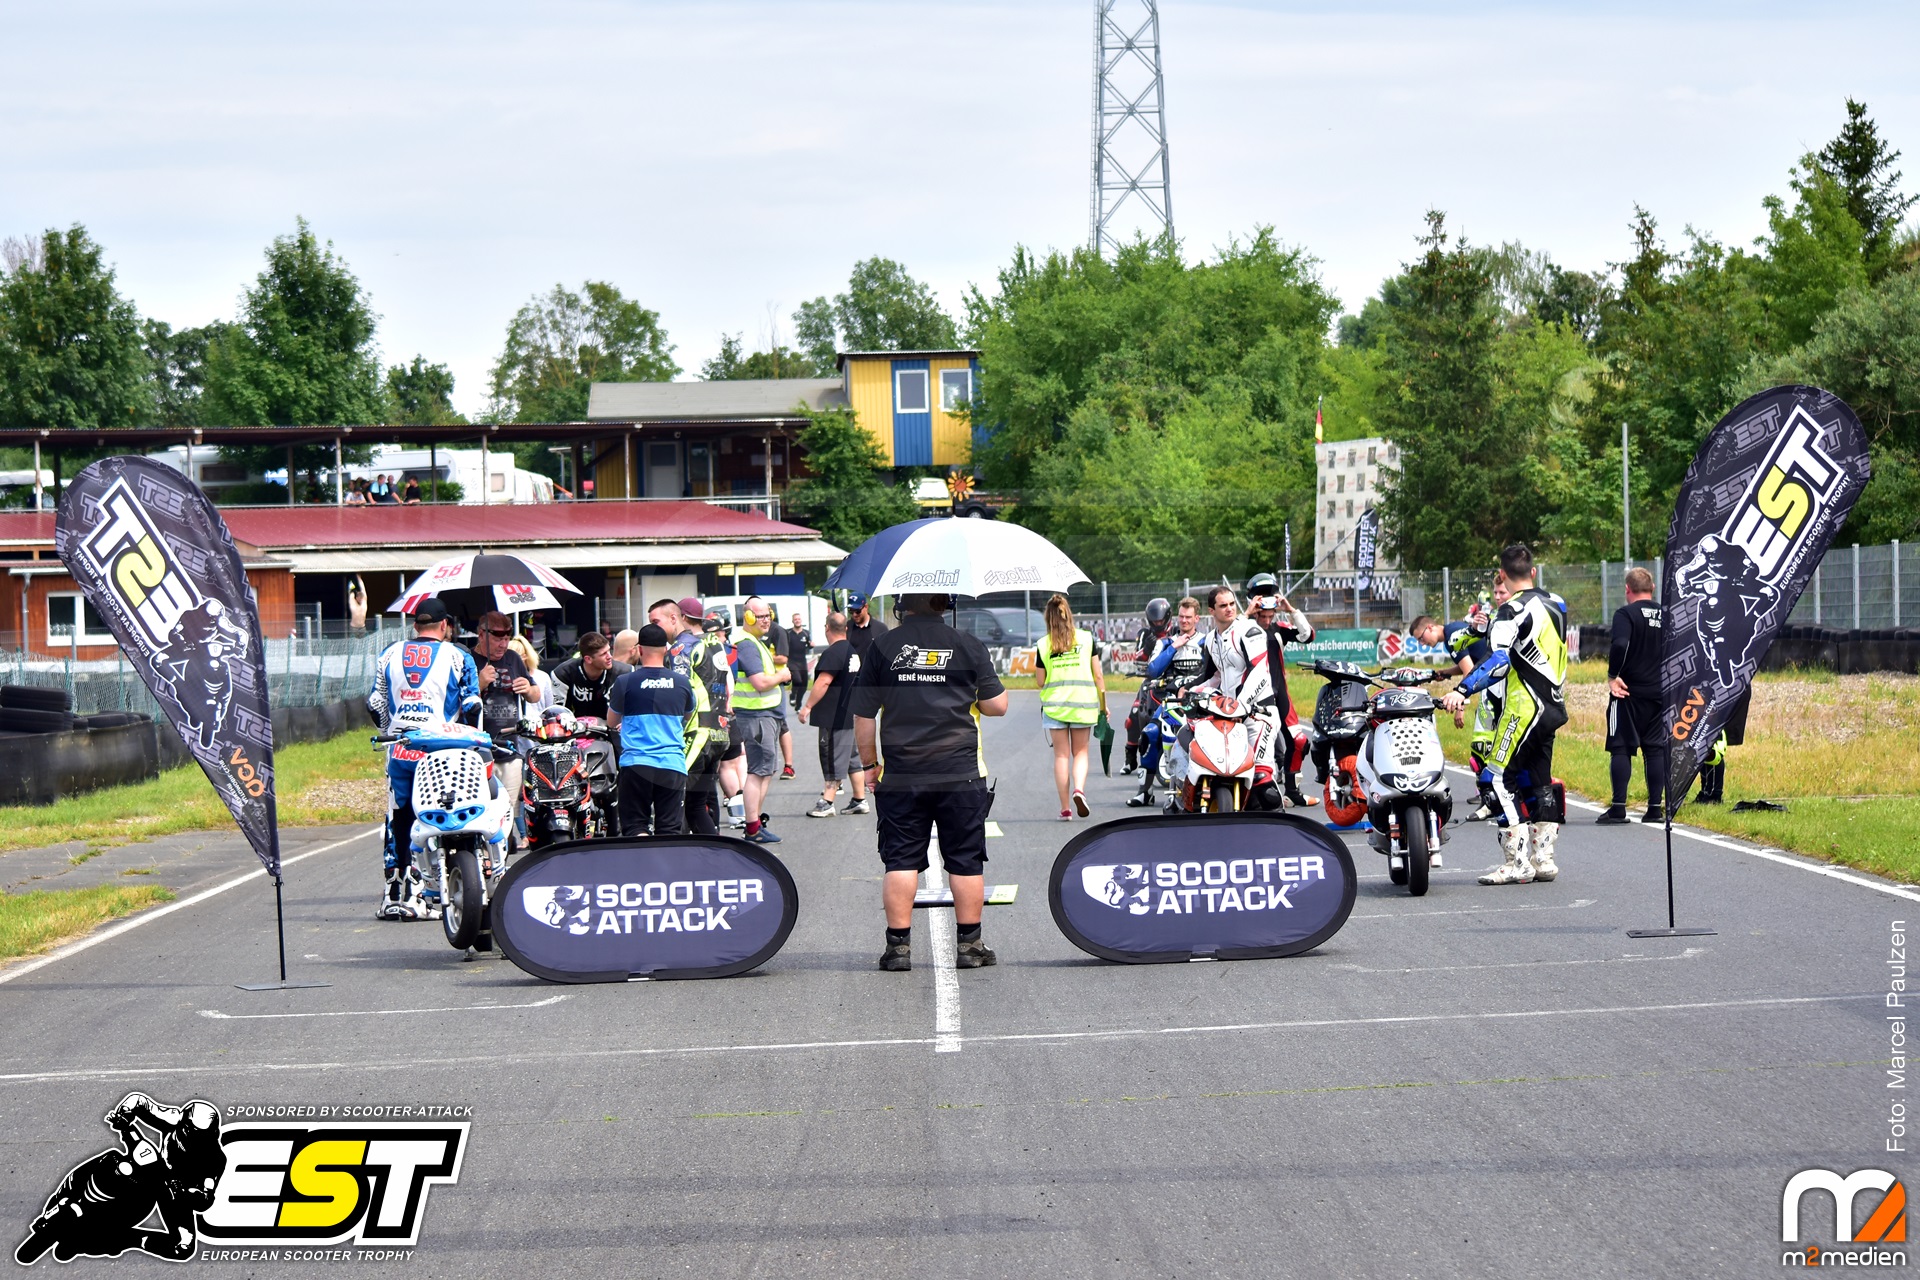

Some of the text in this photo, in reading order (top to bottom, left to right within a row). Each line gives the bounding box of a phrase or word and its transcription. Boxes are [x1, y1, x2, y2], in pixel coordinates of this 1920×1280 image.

[1737, 406, 1780, 447] EST
[1727, 414, 1838, 580] EST
[1779, 546, 1809, 590] EUROPEAN
[1805, 507, 1831, 546] SCOOTER
[1828, 475, 1852, 513] TROPHY
[434, 563, 466, 579] 58
[909, 569, 960, 587] polini
[994, 566, 1041, 585] polini
[403, 644, 433, 668] 58
[1306, 639, 1375, 653] Versicherungen
[916, 650, 952, 667] EST
[898, 673, 946, 683] RENÉ HANSEN
[404, 703, 434, 715] polini
[1495, 714, 1521, 763] BERIK
[1155, 856, 1326, 887] SCOOTER
[596, 879, 764, 908] SCOOTER
